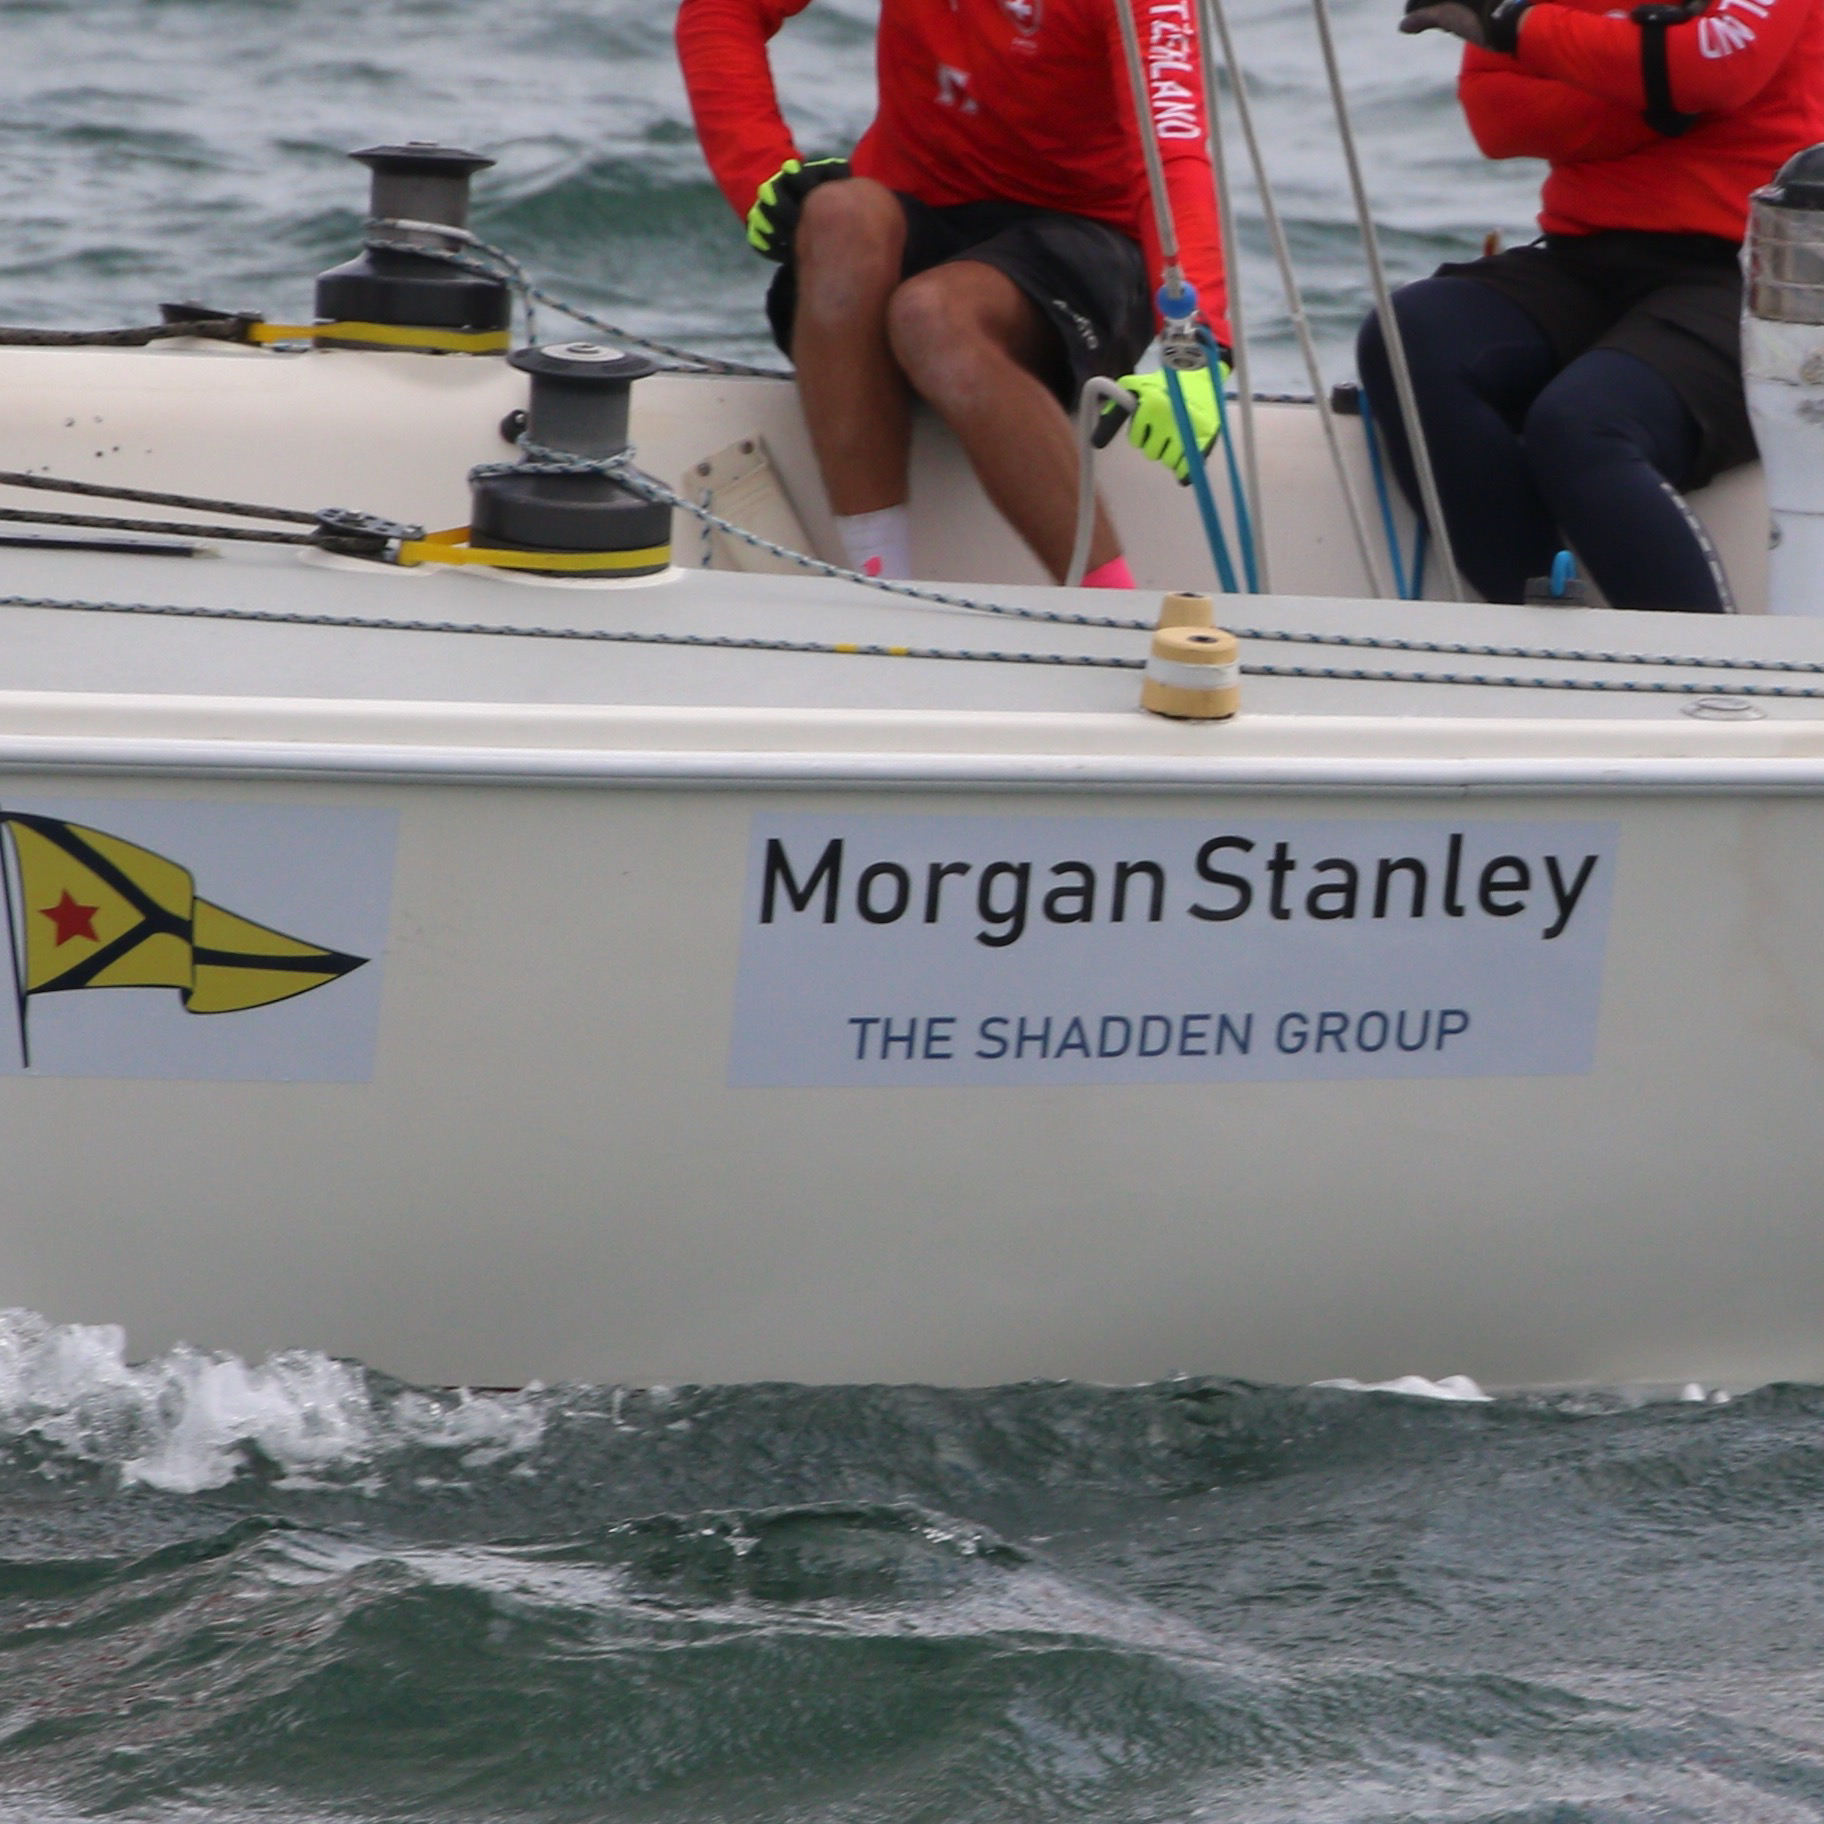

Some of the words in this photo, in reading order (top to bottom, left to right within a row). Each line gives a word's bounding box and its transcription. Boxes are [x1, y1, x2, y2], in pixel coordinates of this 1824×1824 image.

[848, 1015, 957, 1061] THE
[975, 1012, 1254, 1060] SHADDEN
[1275, 1008, 1472, 1056] GROUP
